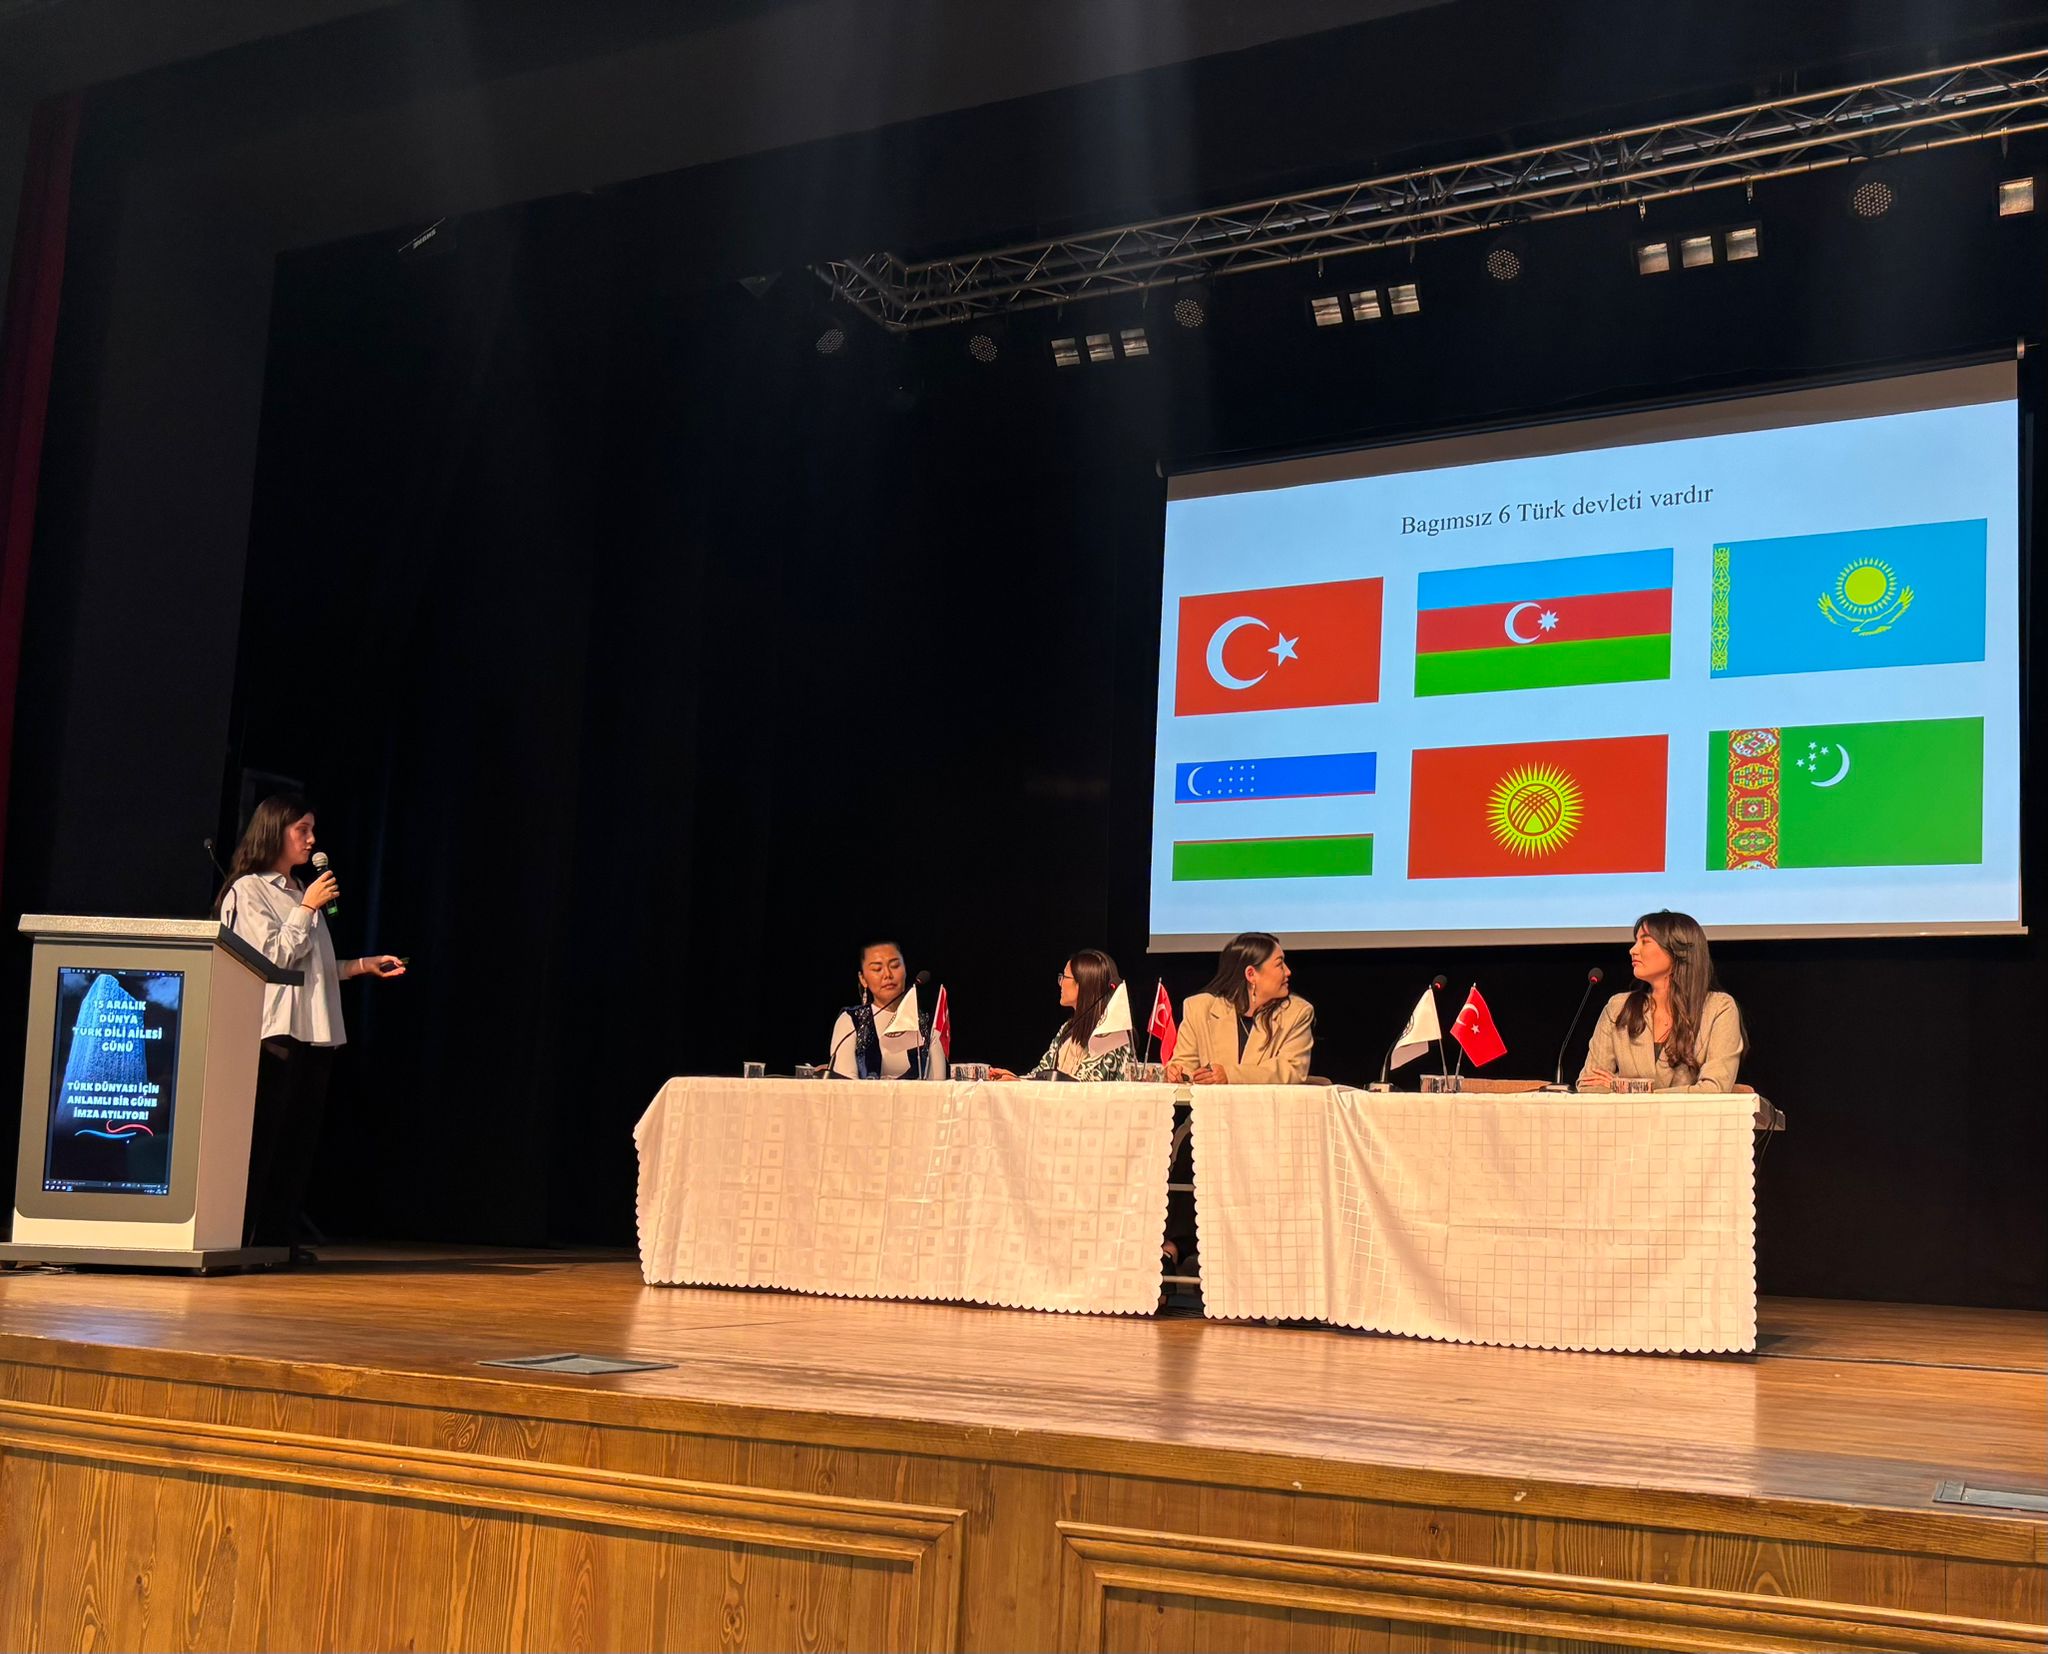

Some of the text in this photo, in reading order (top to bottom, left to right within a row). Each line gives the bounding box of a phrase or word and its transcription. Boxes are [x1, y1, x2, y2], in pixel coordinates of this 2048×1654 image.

[1499, 504, 1511, 524] 6
[1517, 499, 1565, 521] Türk
[1572, 490, 1642, 516] devleti
[1650, 485, 1714, 507] vardır
[94, 1001, 146, 1010] 15 ARALIK
[100, 1012, 138, 1024] DÜNYA
[104, 1026, 126, 1037] DİLİ
[127, 1027, 162, 1039] AİLESİ
[67, 1081, 159, 1095] TÜRK DÜNYASI İÇİN
[67, 1095, 111, 1105] ANLAMLI
[112, 1096, 129, 1106] BİR
[73, 1107, 99, 1118] İMZA
